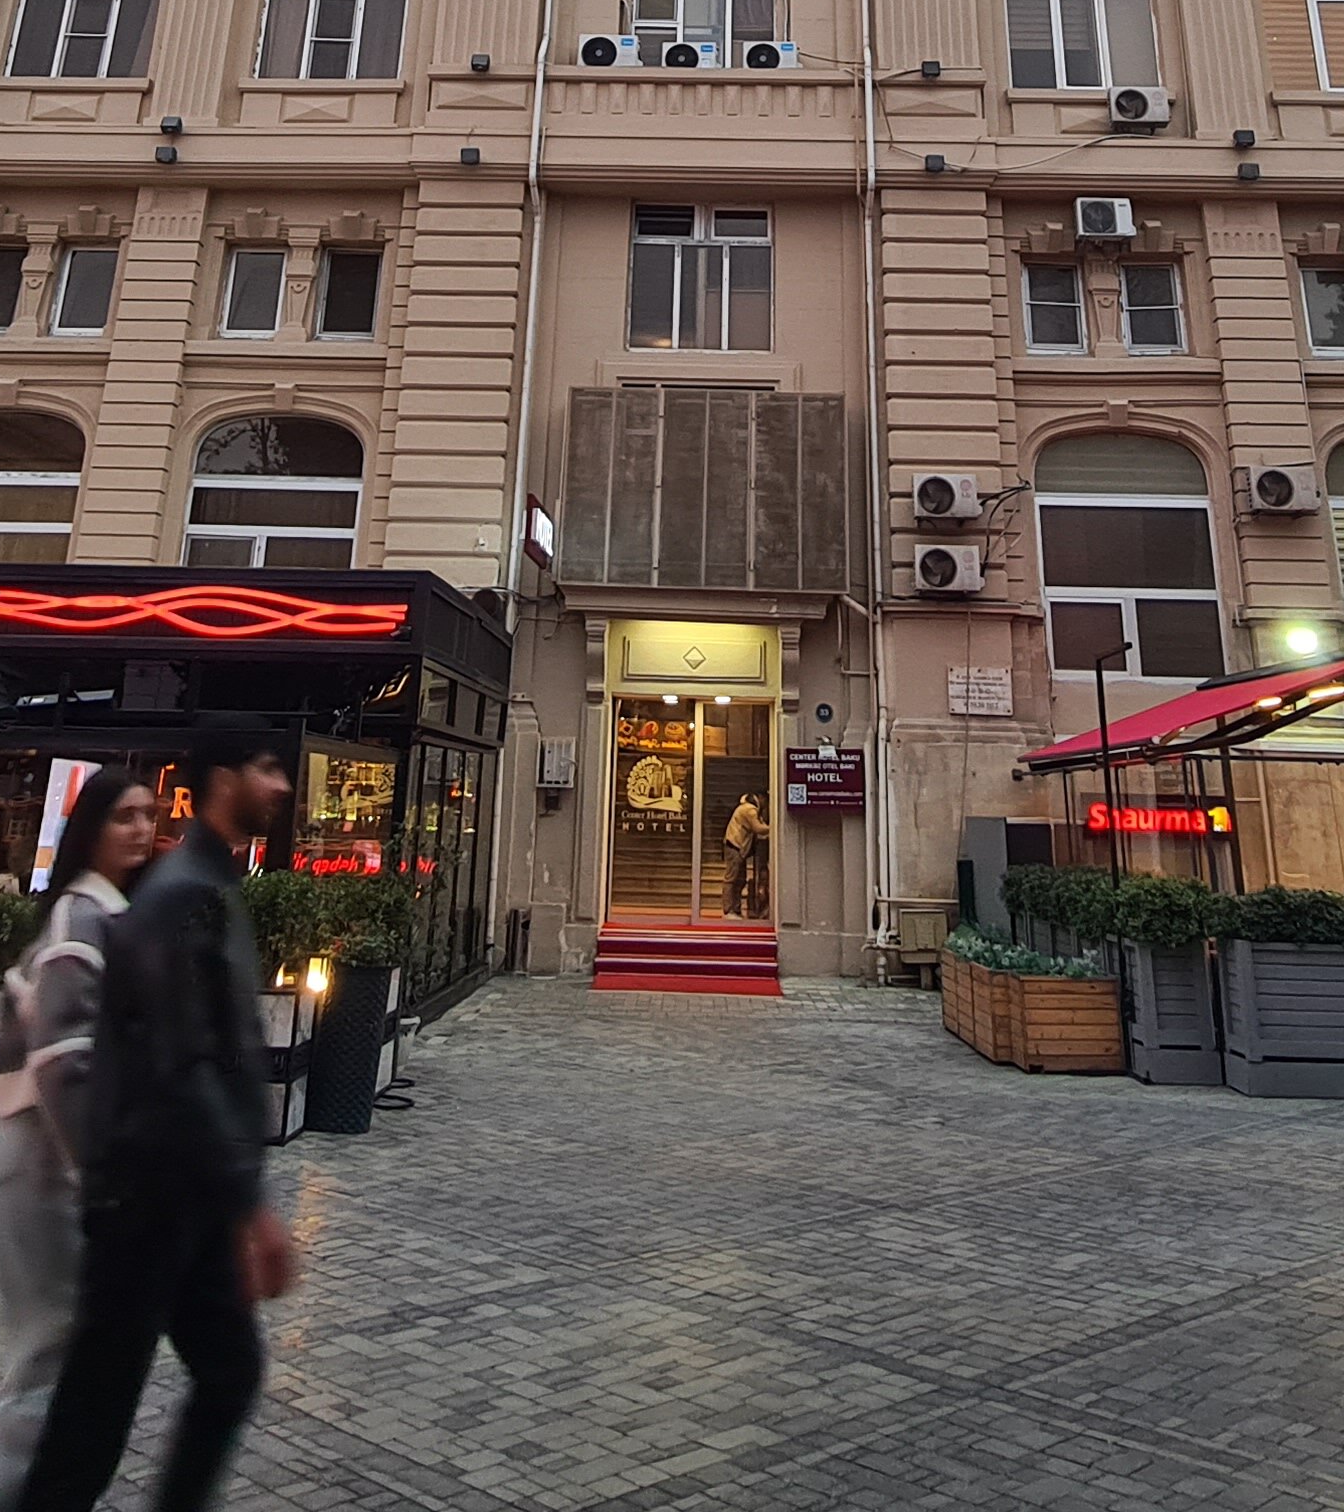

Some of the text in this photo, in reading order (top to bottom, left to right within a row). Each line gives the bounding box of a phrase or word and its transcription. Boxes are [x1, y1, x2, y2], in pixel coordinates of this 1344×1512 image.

[789, 753, 817, 761] CENTER
[841, 754, 861, 762] BAKU
[807, 772, 843, 783] HOTEL
[622, 822, 686, 833] HOTEL
